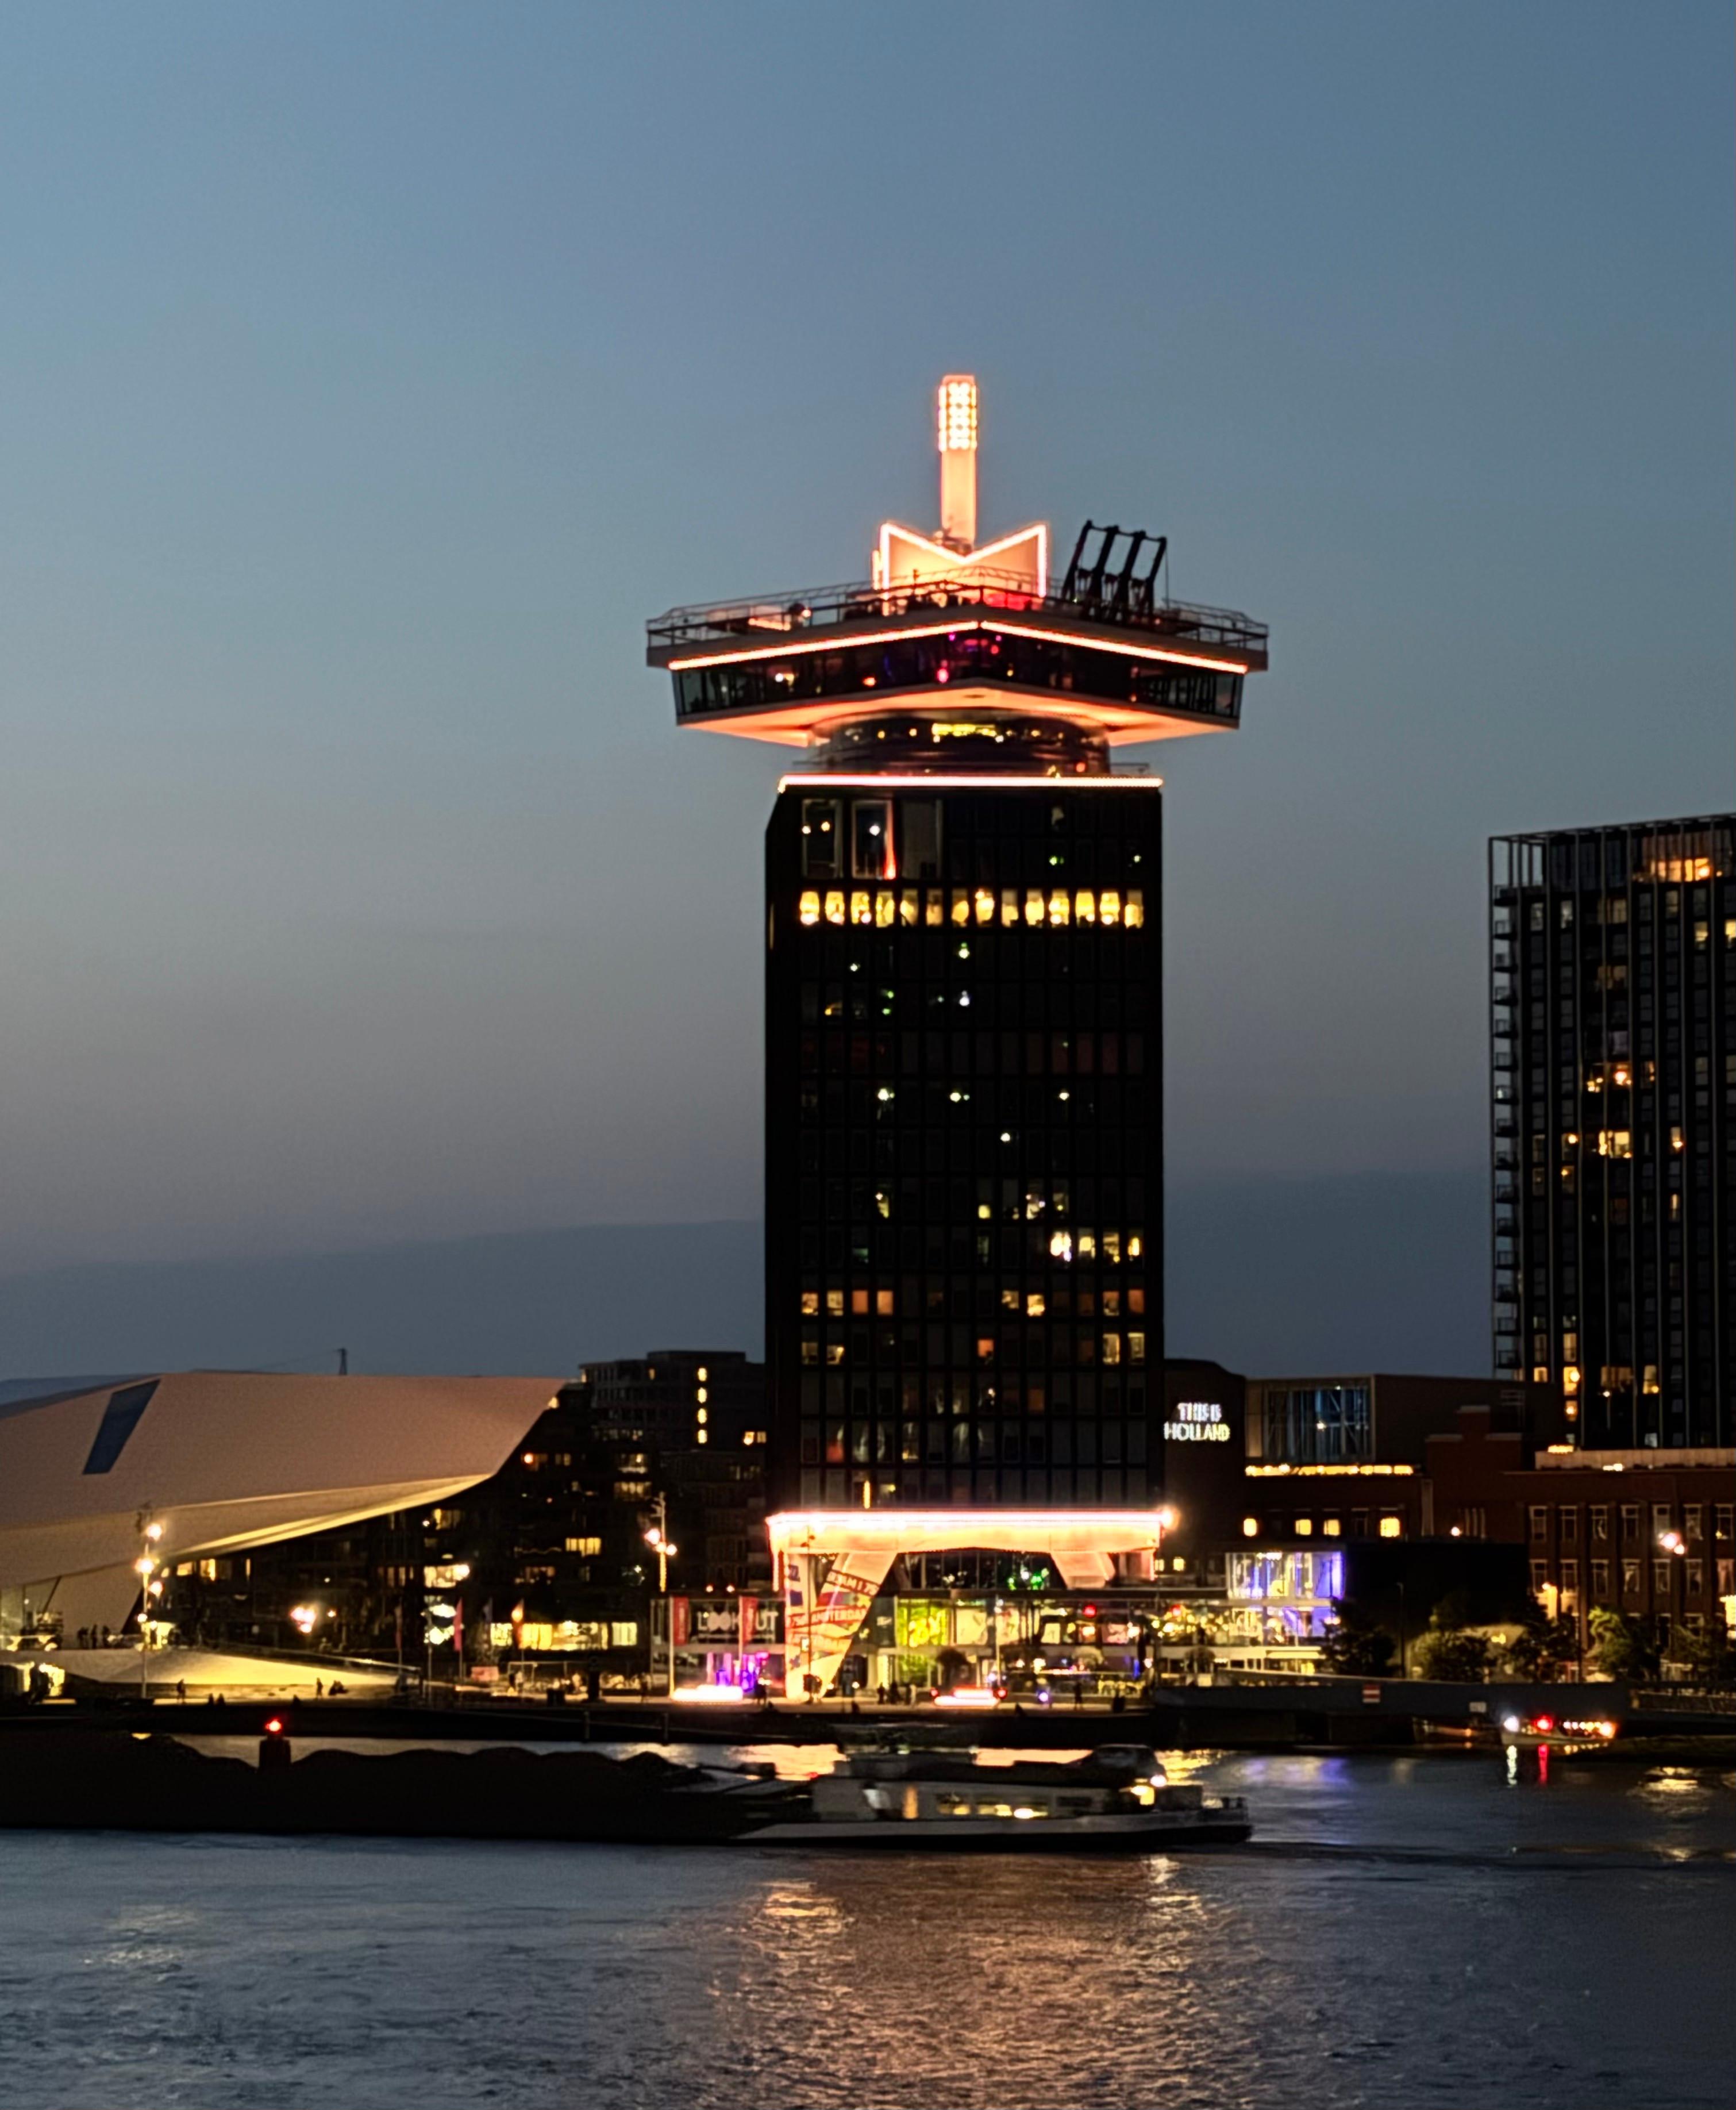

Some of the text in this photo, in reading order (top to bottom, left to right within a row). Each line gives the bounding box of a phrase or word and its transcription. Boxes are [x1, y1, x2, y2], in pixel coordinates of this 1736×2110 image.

[1177, 1402, 1222, 1423] THIS IS
[1163, 1421, 1230, 1442] HOLLAND
